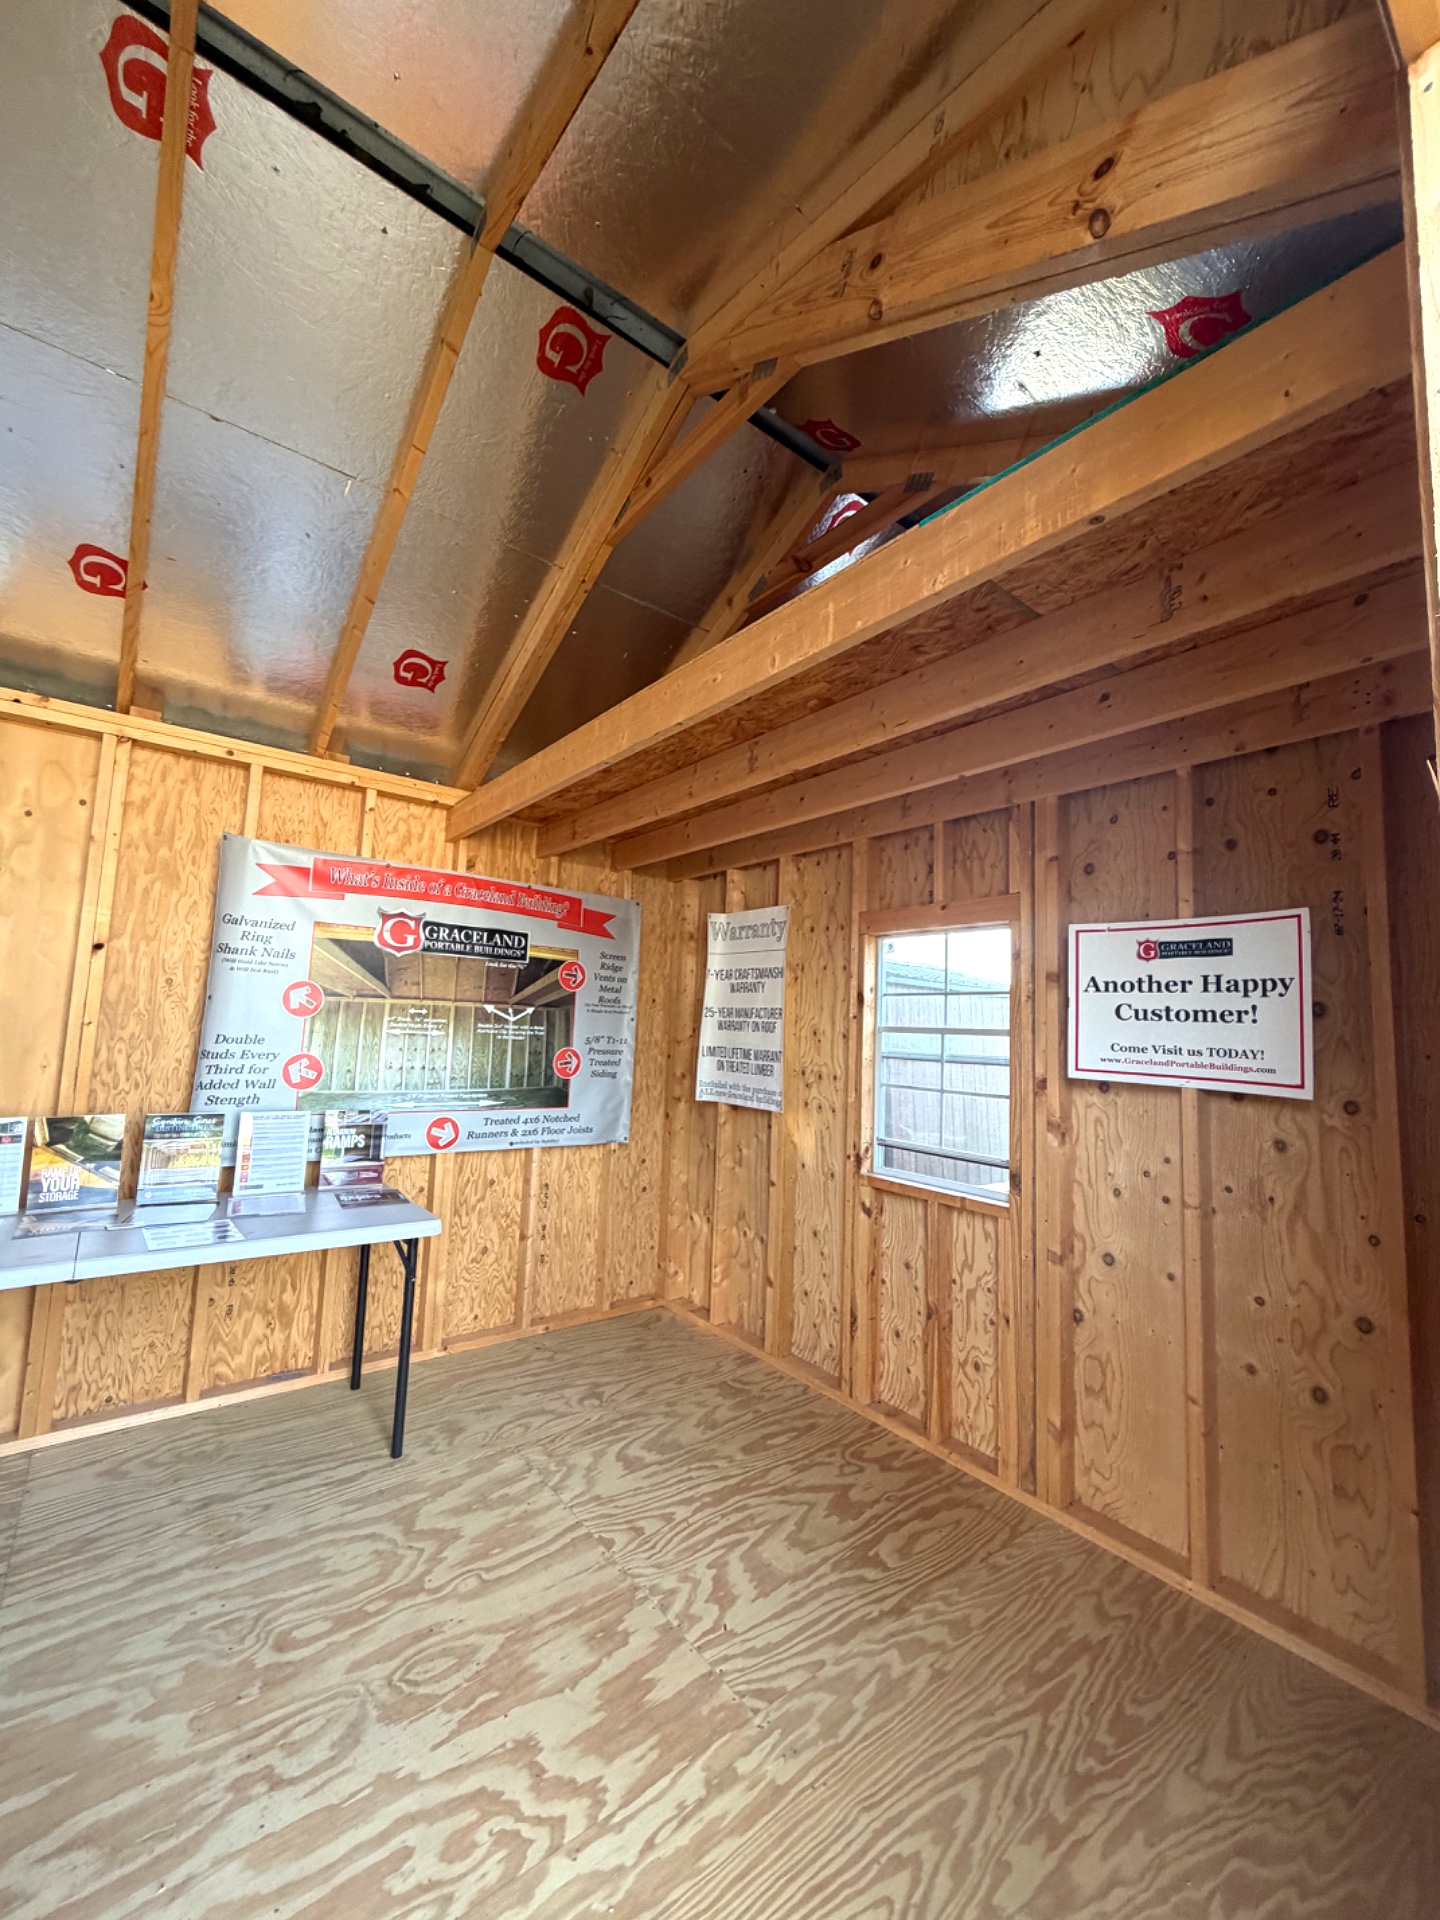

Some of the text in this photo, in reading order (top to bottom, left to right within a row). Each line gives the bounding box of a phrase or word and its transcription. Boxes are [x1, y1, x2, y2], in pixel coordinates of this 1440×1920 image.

[544, 322, 588, 375] G
[79, 555, 126, 591] G
[399, 657, 432, 683] G
[329, 866, 380, 888] What's
[381, 872, 426, 893] Inside
[427, 878, 446, 896] of
[443, 886, 452, 897] a
[454, 881, 516, 907] Graceland
[221, 913, 297, 932] Galvanized
[709, 918, 787, 942] Warranty
[239, 930, 273, 946] Ring
[382, 917, 418, 948] G
[424, 925, 526, 949] GRACELAND
[215, 942, 297, 960] Shank Nails
[424, 940, 473, 954] PORTABLE
[1139, 942, 1155, 959] G
[1160, 940, 1231, 951] GRACELAND
[599, 951, 627, 962] Screen
[599, 961, 625, 974] Ridge
[593, 972, 628, 983] Vents on
[598, 984, 623, 994] Metal
[729, 981, 766, 994] WARRANTY
[1083, 974, 1296, 998] Another Happy
[597, 995, 622, 1005] Roofs
[704, 1006, 735, 1019] 25-YEAR
[1114, 1003, 1259, 1025] Customer!
[716, 1020, 777, 1034] WARRANTY ON ROOF
[214, 1033, 266, 1046] Double
[200, 1048, 281, 1062] Studs Every
[586, 1047, 625, 1059] Pressure
[701, 1045, 728, 1058] LIMITED
[727, 1046, 753, 1060] LIFETIME
[1110, 1042, 1265, 1061] Come Visit us TODAY!
[205, 1063, 270, 1076] Third for
[588, 1058, 621, 1068] Treated
[716, 1059, 776, 1078] ON TREATED LUMBER
[1100, 1056, 1277, 1075] www.GracelandPortableBuildings.com
[590, 1069, 618, 1080] Siding
[195, 1078, 276, 1091] Added Wall
[699, 1079, 728, 1089] Included
[728, 1082, 741, 1091] with
[741, 1083, 751, 1092] the
[752, 1086, 777, 1097] purchase
[203, 1093, 261, 1108] Stength
[483, 1112, 582, 1127] Treated 4x6 Notched
[384, 1132, 412, 1141] roducts
[466, 1124, 594, 1141] Runners & 2x6 Floor Joists
[324, 1134, 366, 1149] RAMPS
[41, 1166, 82, 1178] RAMP UP
[41, 1176, 80, 1192] YOUR
[38, 1191, 79, 1203] STORAGE
